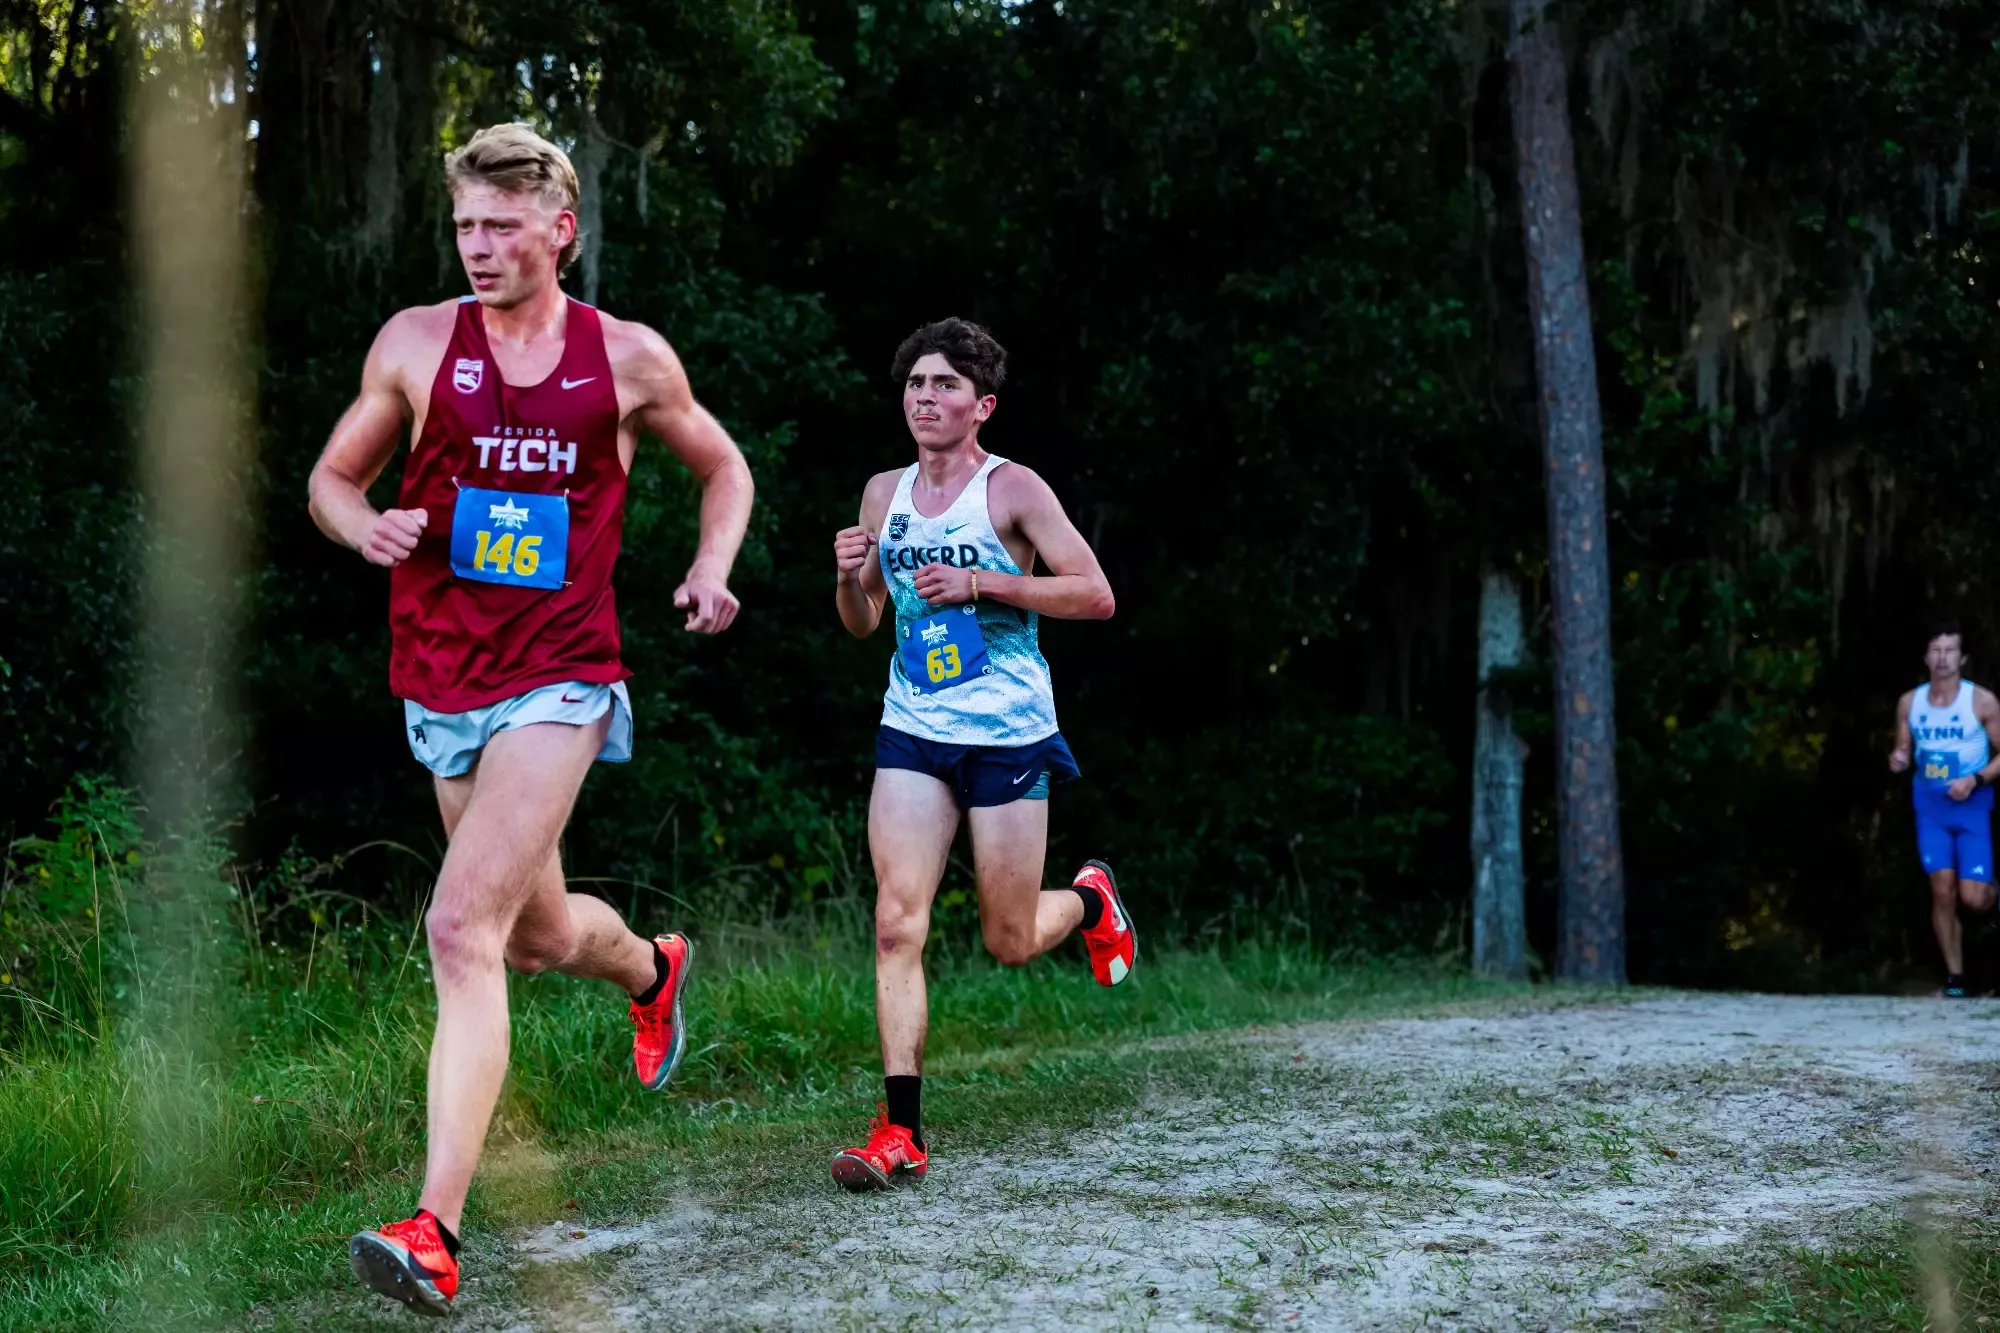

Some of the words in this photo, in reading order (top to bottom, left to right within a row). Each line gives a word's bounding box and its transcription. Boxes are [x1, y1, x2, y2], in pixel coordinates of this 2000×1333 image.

[472, 437, 577, 474] TECH
[474, 530, 543, 577] 146
[886, 544, 979, 573] ECKERD
[926, 643, 962, 684] 63
[1912, 727, 1964, 741] LYNN
